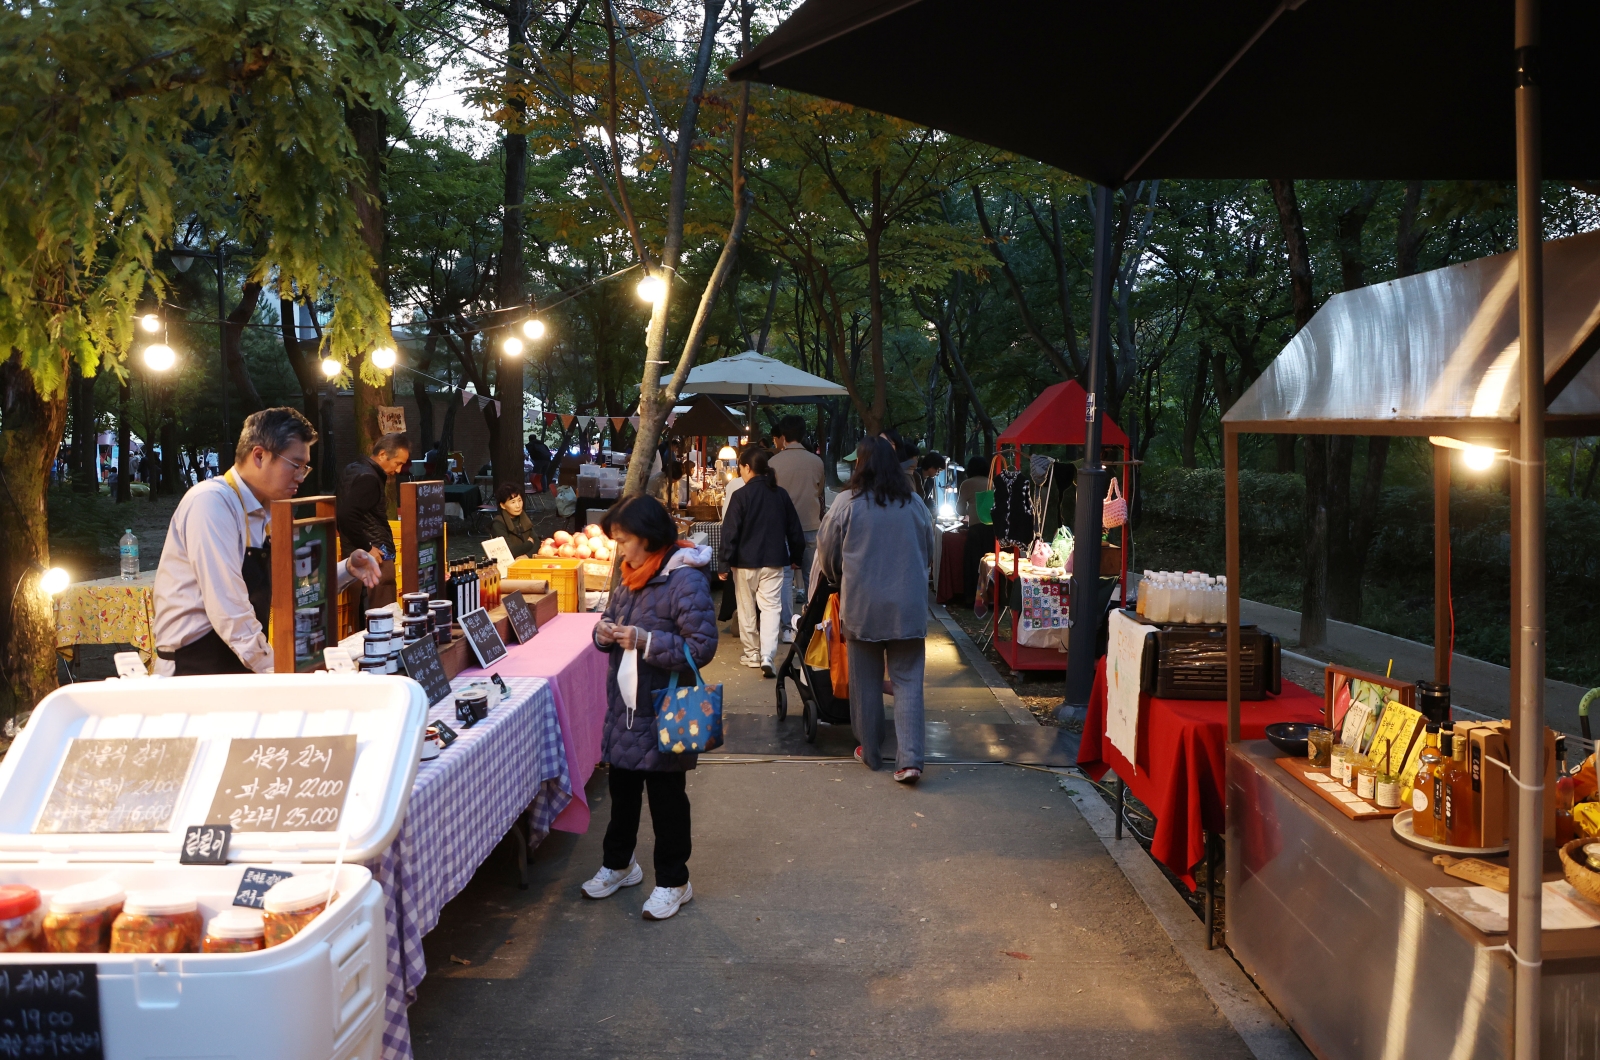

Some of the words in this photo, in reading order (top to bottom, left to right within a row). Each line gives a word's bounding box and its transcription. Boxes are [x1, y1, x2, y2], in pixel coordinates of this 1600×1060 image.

[291, 744, 333, 773] 김치
[234, 777, 260, 800] 파
[283, 806, 339, 828] 25,000
